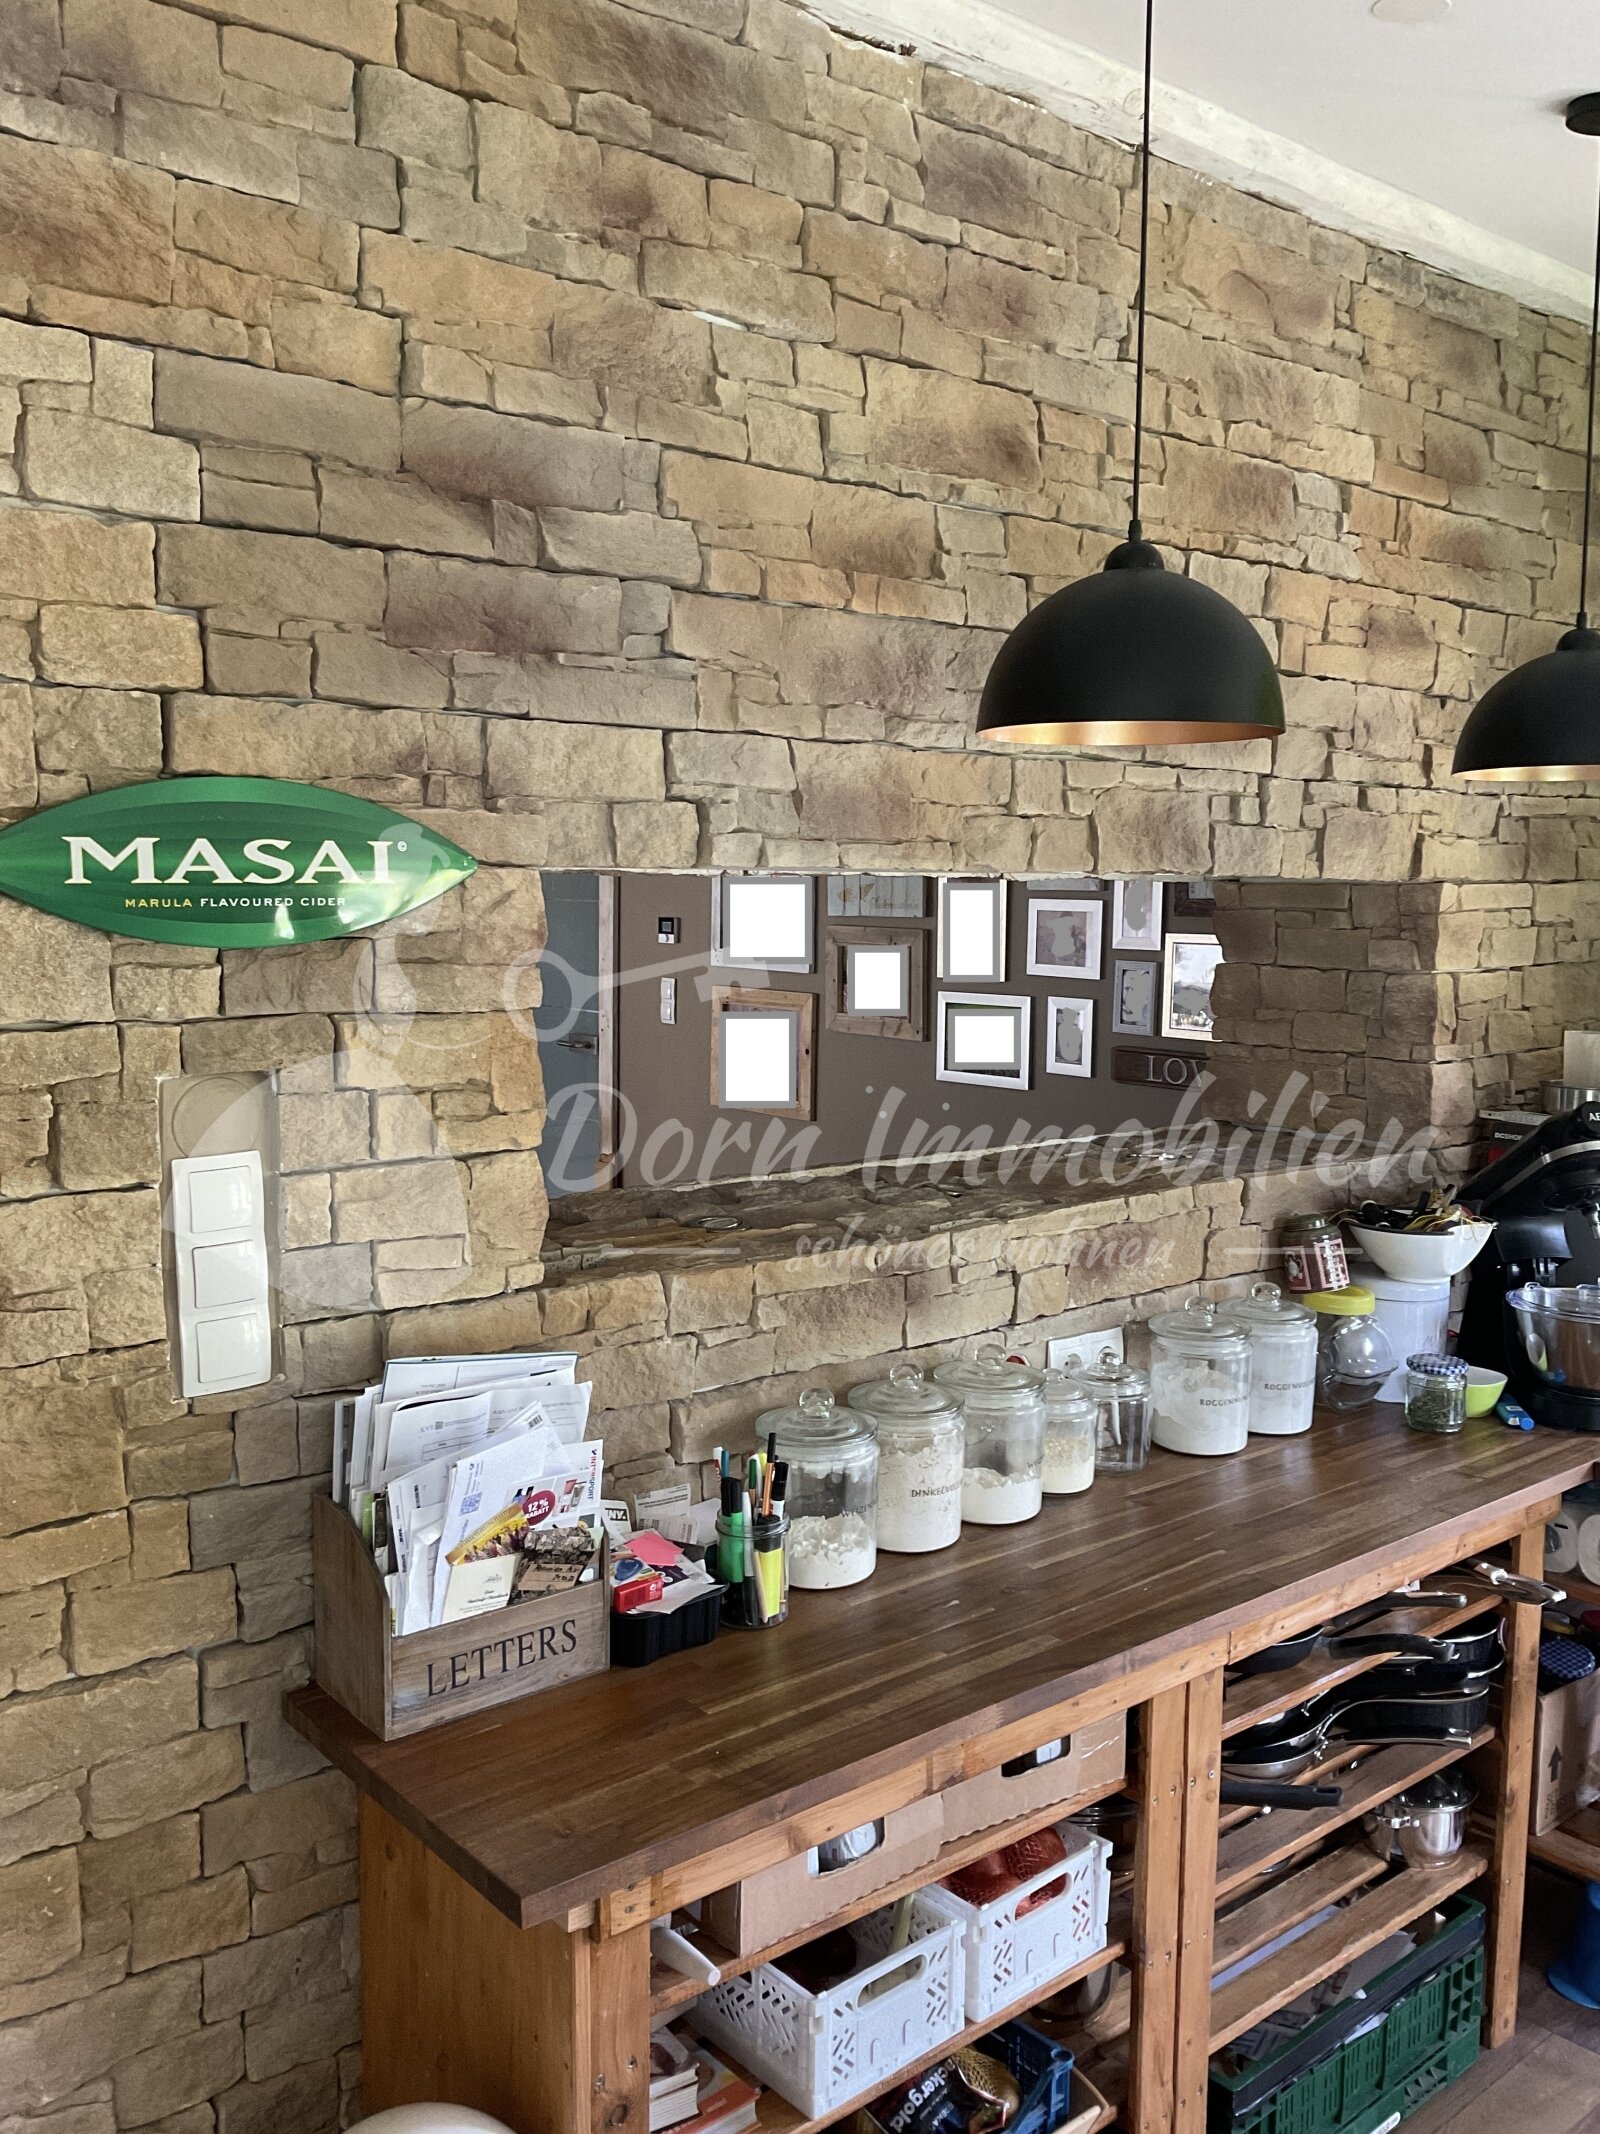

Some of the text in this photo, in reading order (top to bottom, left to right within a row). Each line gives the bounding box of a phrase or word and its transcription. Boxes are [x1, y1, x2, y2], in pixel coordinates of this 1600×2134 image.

[61, 836, 394, 885] MASAI
[124, 897, 346, 908] MARULA FLAVOURED CIDER
[427, 1619, 577, 1698] LETTERS
